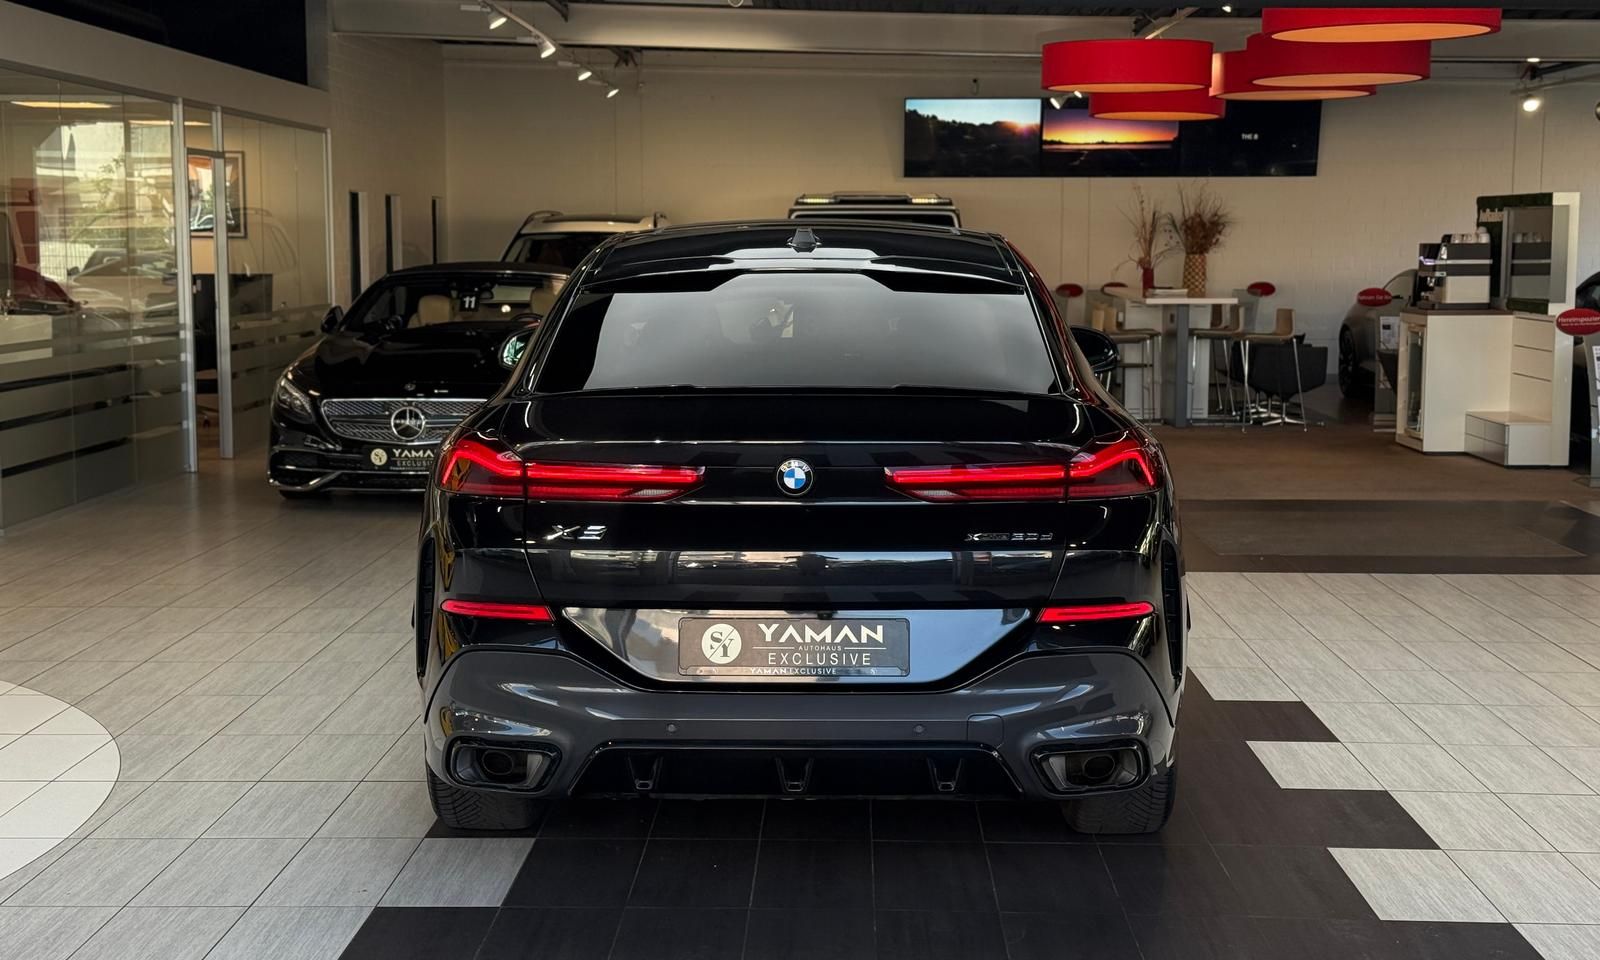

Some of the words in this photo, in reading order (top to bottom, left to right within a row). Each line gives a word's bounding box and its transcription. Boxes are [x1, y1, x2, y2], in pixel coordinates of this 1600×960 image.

[393, 448, 437, 458] YAMA
[757, 623, 884, 644] YAMAN
[768, 652, 871, 665] EXCLUSIVE
[750, 667, 787, 675] YAMAN
[789, 667, 837, 675] EXCLUSIVE
